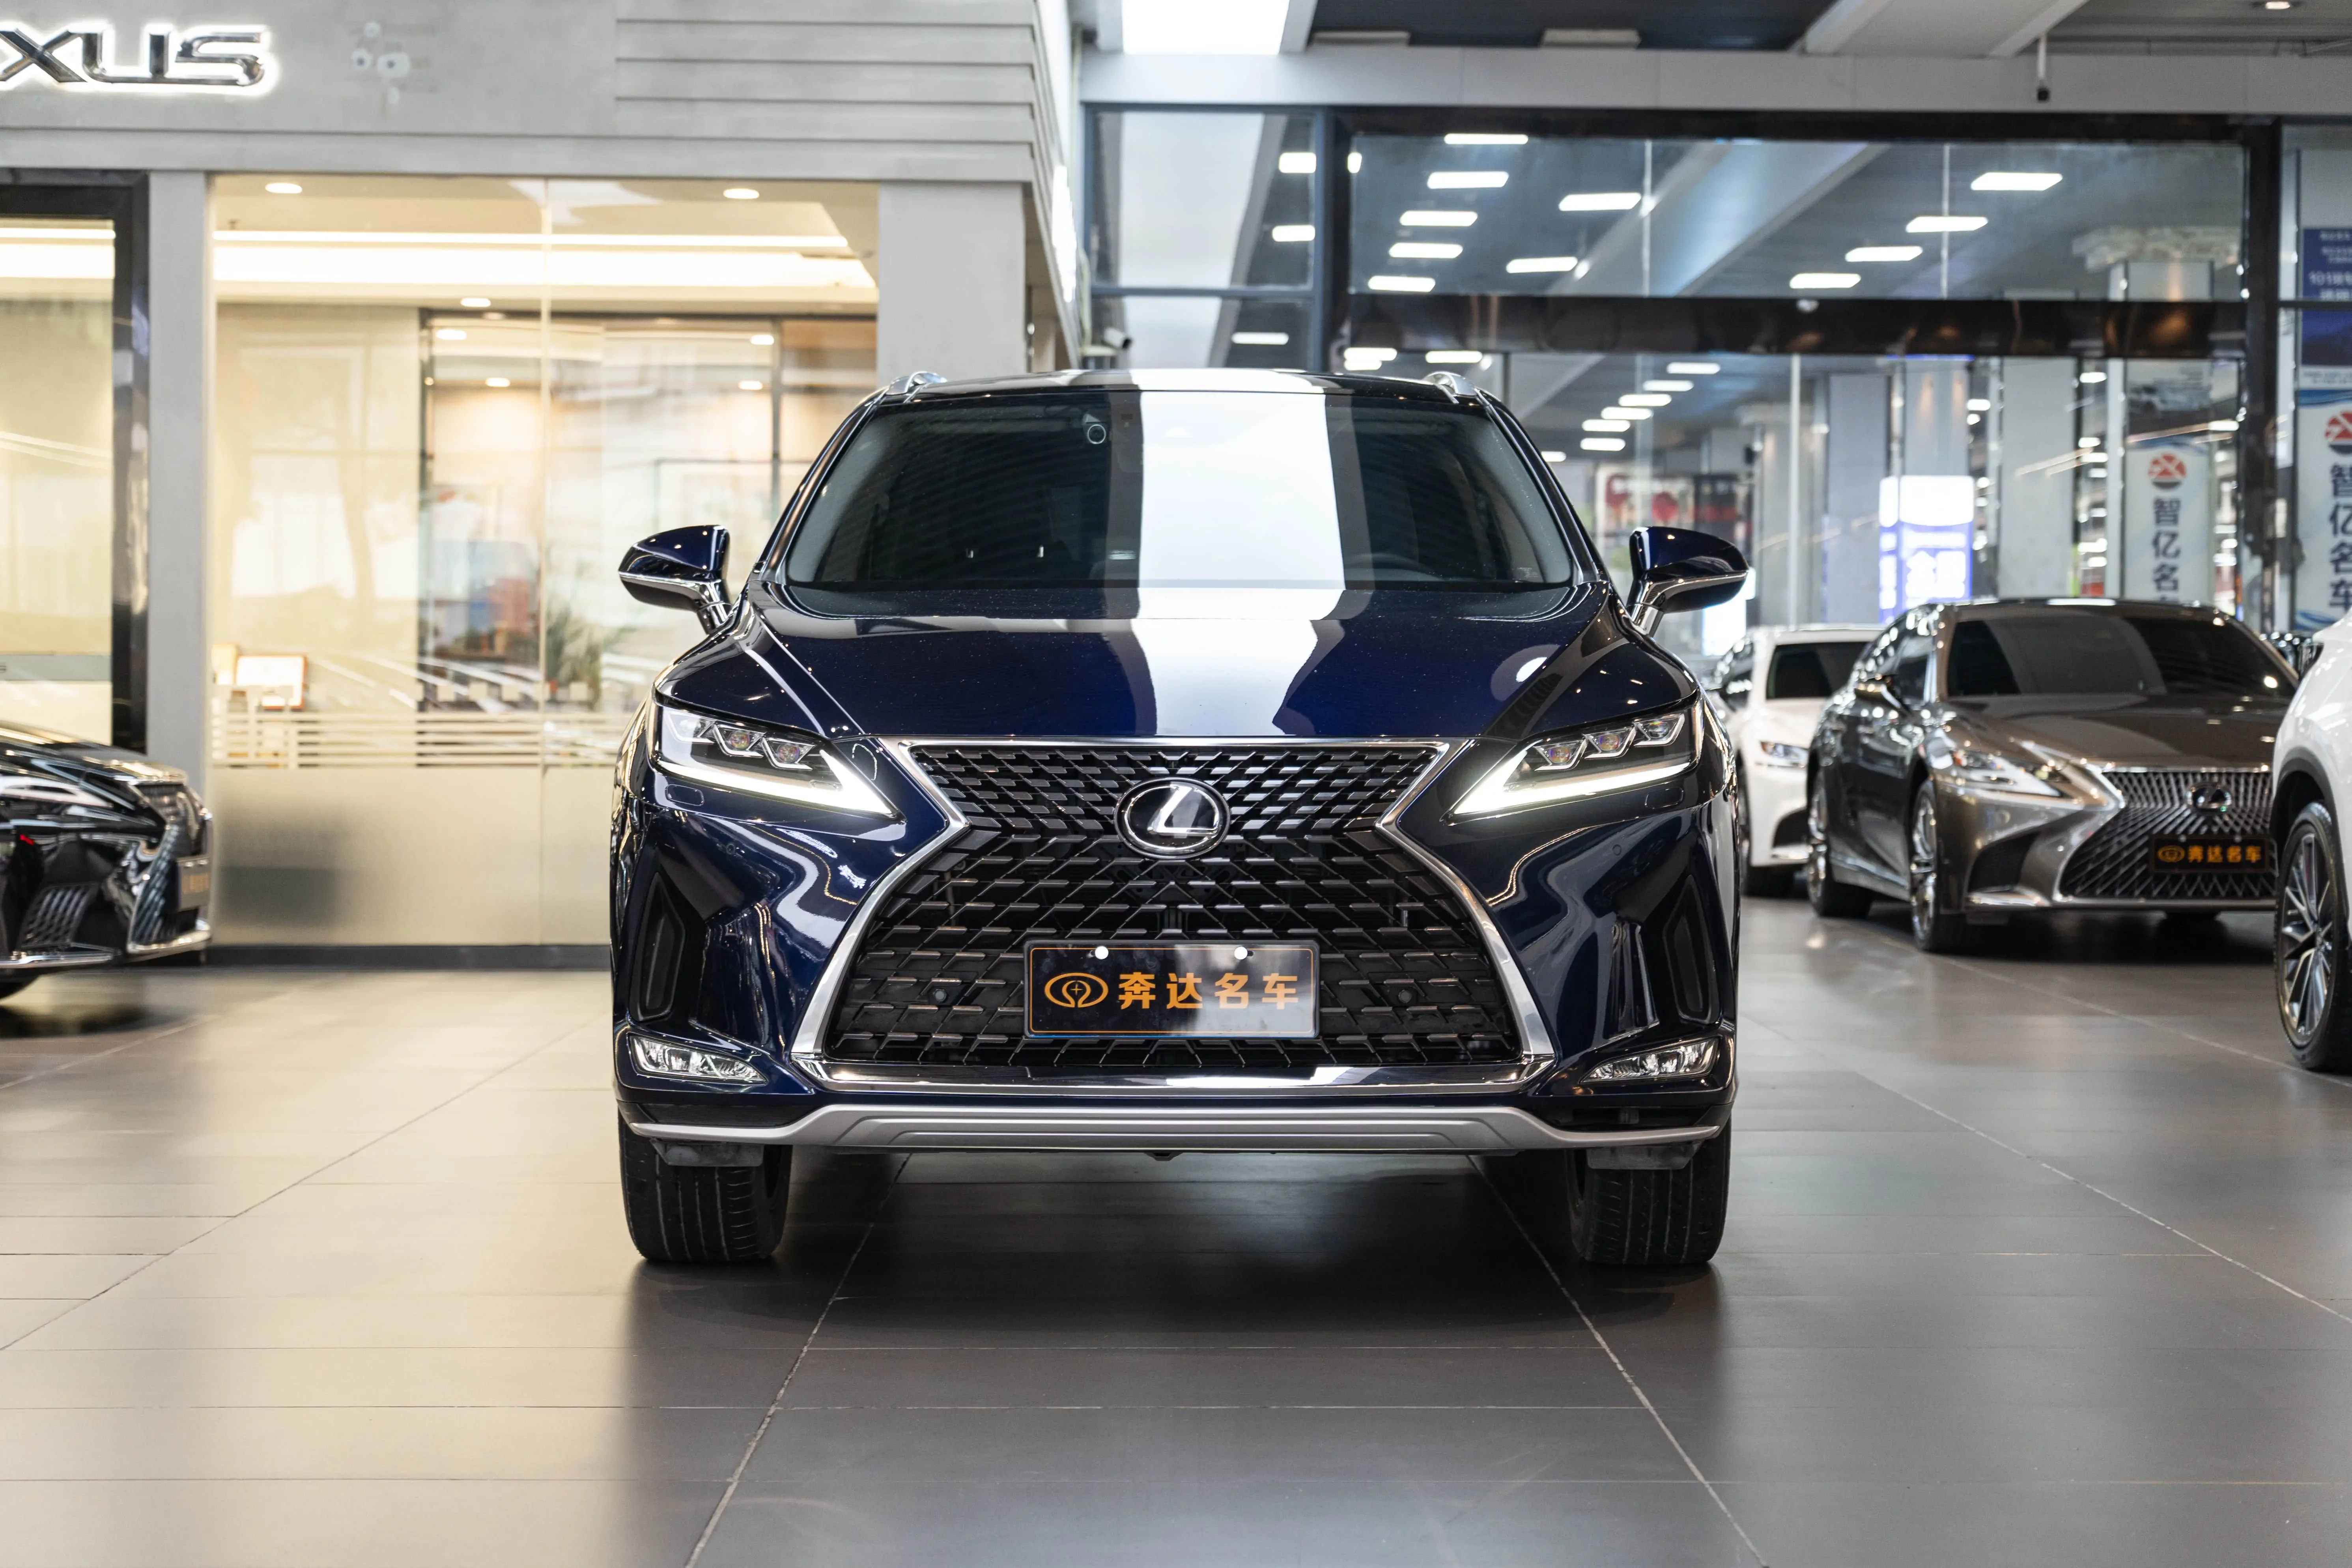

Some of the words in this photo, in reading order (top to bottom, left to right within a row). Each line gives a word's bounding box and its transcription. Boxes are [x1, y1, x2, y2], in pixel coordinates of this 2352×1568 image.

[2152, 498, 2181, 604] 智亿名
[1119, 972, 1298, 1010] 奔达名车
